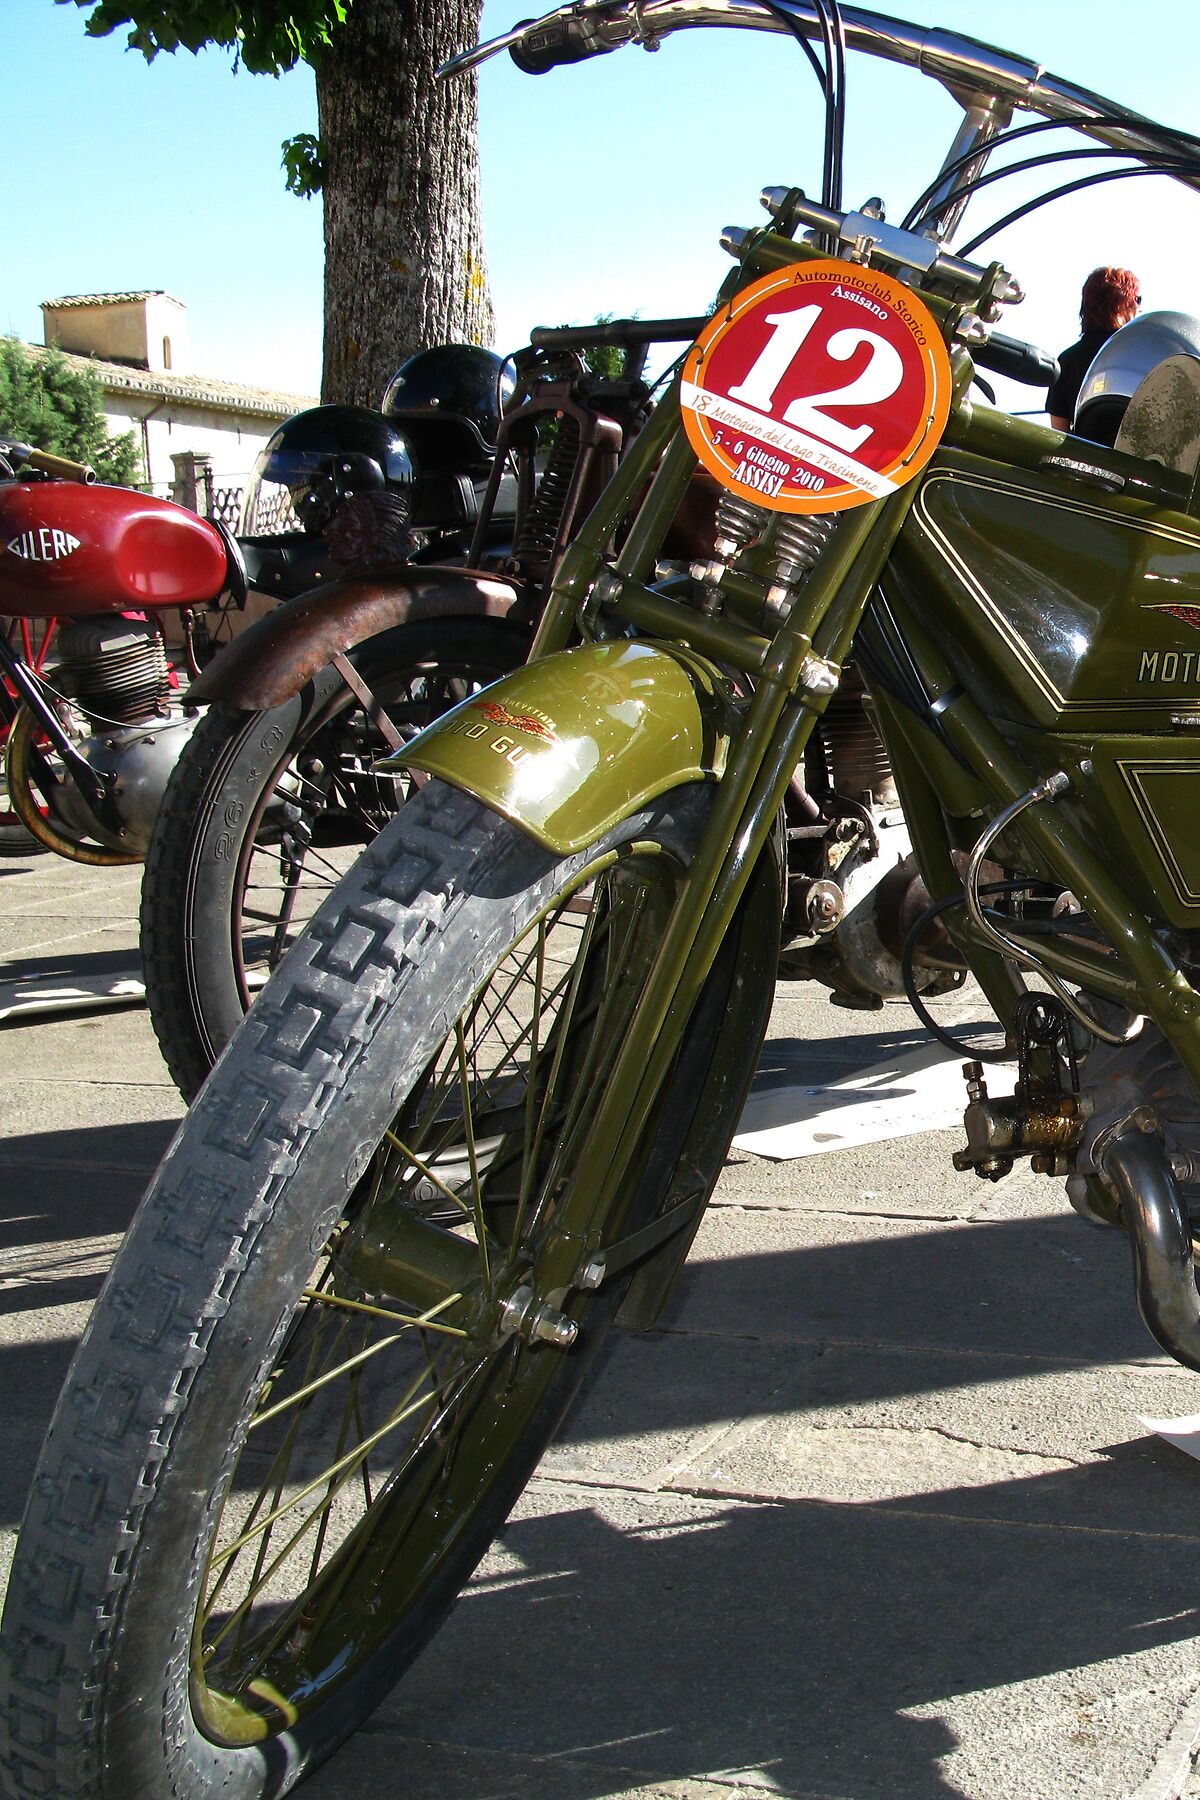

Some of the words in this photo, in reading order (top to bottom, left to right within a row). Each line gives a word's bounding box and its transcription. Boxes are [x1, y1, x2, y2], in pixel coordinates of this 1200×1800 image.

[793, 271, 892, 303] Automotoclub
[891, 299, 928, 347] Storico
[830, 284, 889, 322] Assisano
[726, 303, 905, 454] 12
[711, 406, 762, 435] Motogiro
[762, 426, 784, 447] del
[785, 438, 813, 462] Lago
[816, 451, 880, 493] Trasimeno
[711, 430, 722, 446] 5
[732, 440, 744, 456] 6
[745, 444, 791, 476] Giugno
[793, 467, 826, 494] 2010
[730, 459, 786, 499] ASSISI
[6, 528, 82, 562] GILERA
[437, 719, 490, 739] OTO
[502, 697, 557, 731] BREVETTATA
